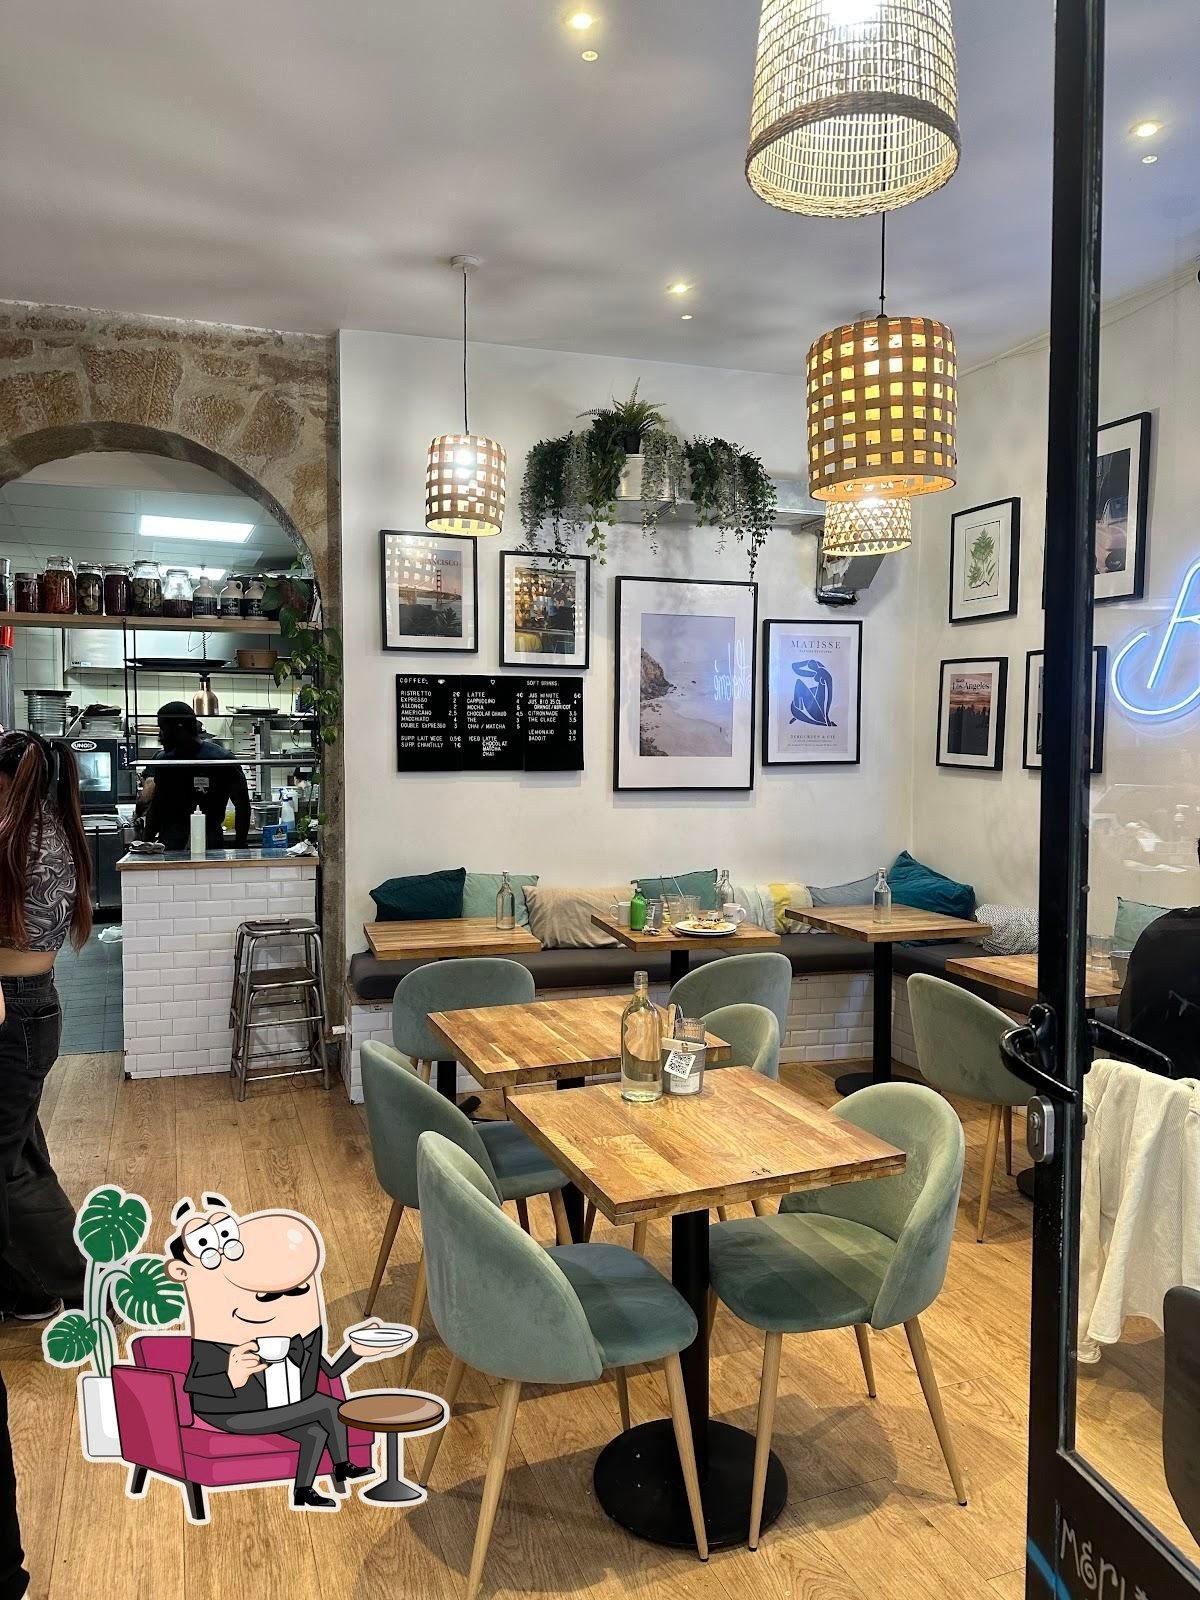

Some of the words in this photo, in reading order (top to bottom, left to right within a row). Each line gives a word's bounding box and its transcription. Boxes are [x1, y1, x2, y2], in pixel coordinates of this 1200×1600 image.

[791, 640, 841, 649] MATISSE
[952, 682, 964, 690] Los
[964, 682, 990, 691] Angeles
